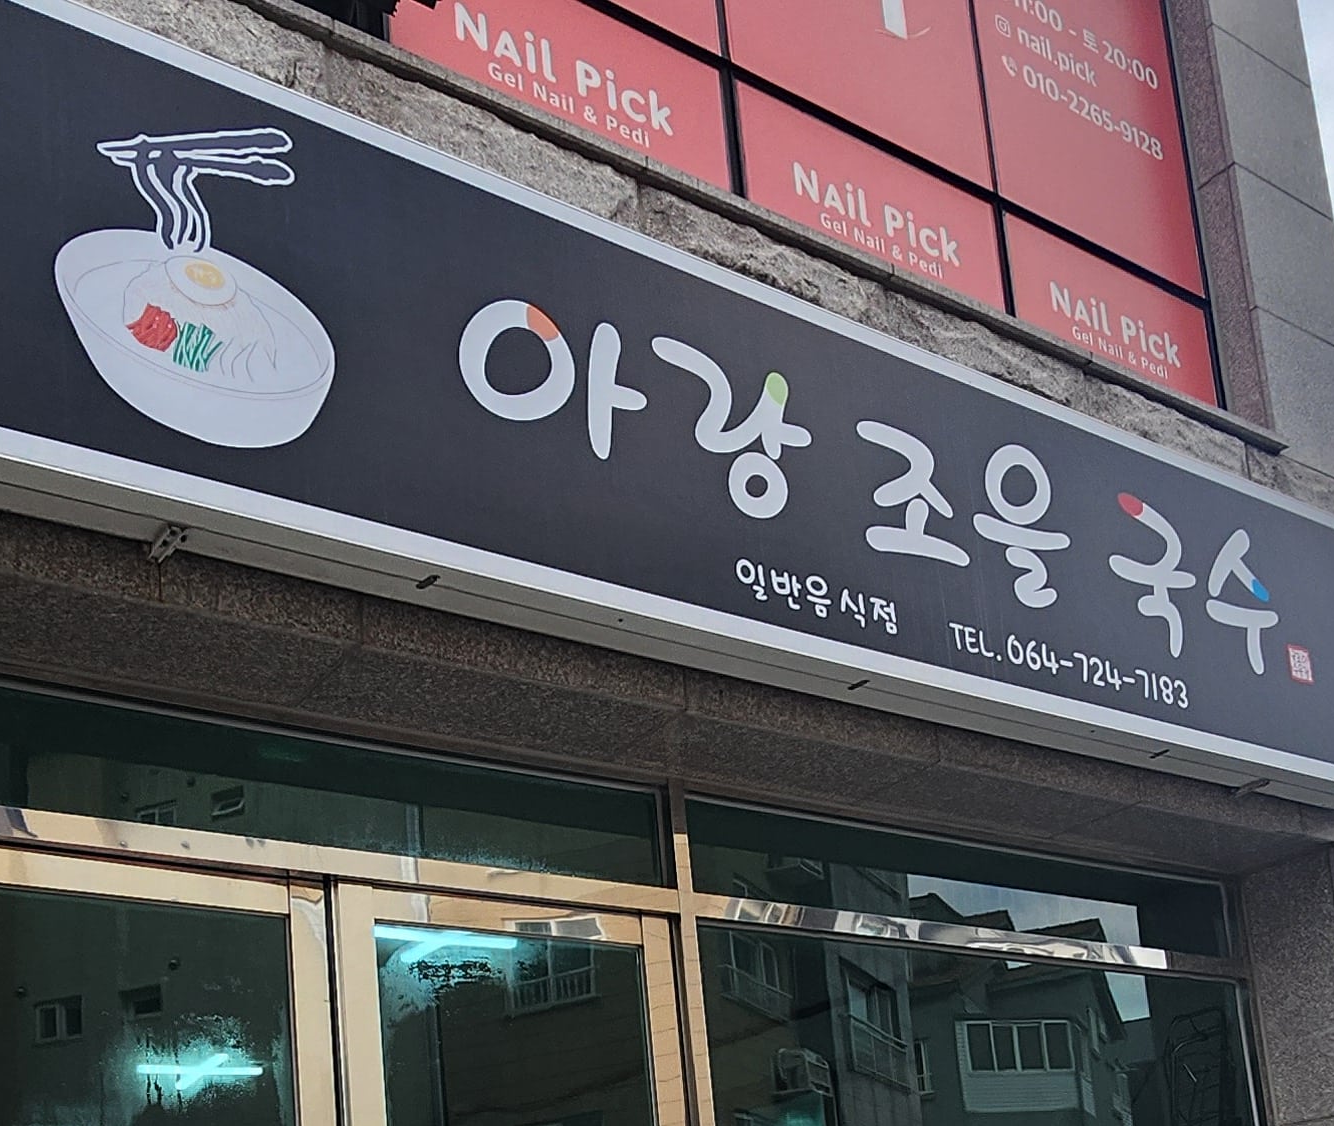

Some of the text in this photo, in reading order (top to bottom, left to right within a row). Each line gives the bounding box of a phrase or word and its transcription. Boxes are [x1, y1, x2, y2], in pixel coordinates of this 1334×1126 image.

[1017, 27, 1097, 87] nail.pick
[1083, 29, 1098, 53] 토
[1103, 41, 1158, 89] 20:00
[488, 62, 649, 148] Gel Nail & Pedi
[1023, 65, 1163, 160] 010-2265-9128
[820, 213, 943, 278] Gel Nail & Pedi
[1072, 326, 1168, 379] Gel Nail & Pedi
[458, 299, 1280, 676] 아랑 조을 국수
[735, 558, 899, 635] 일반음식점
